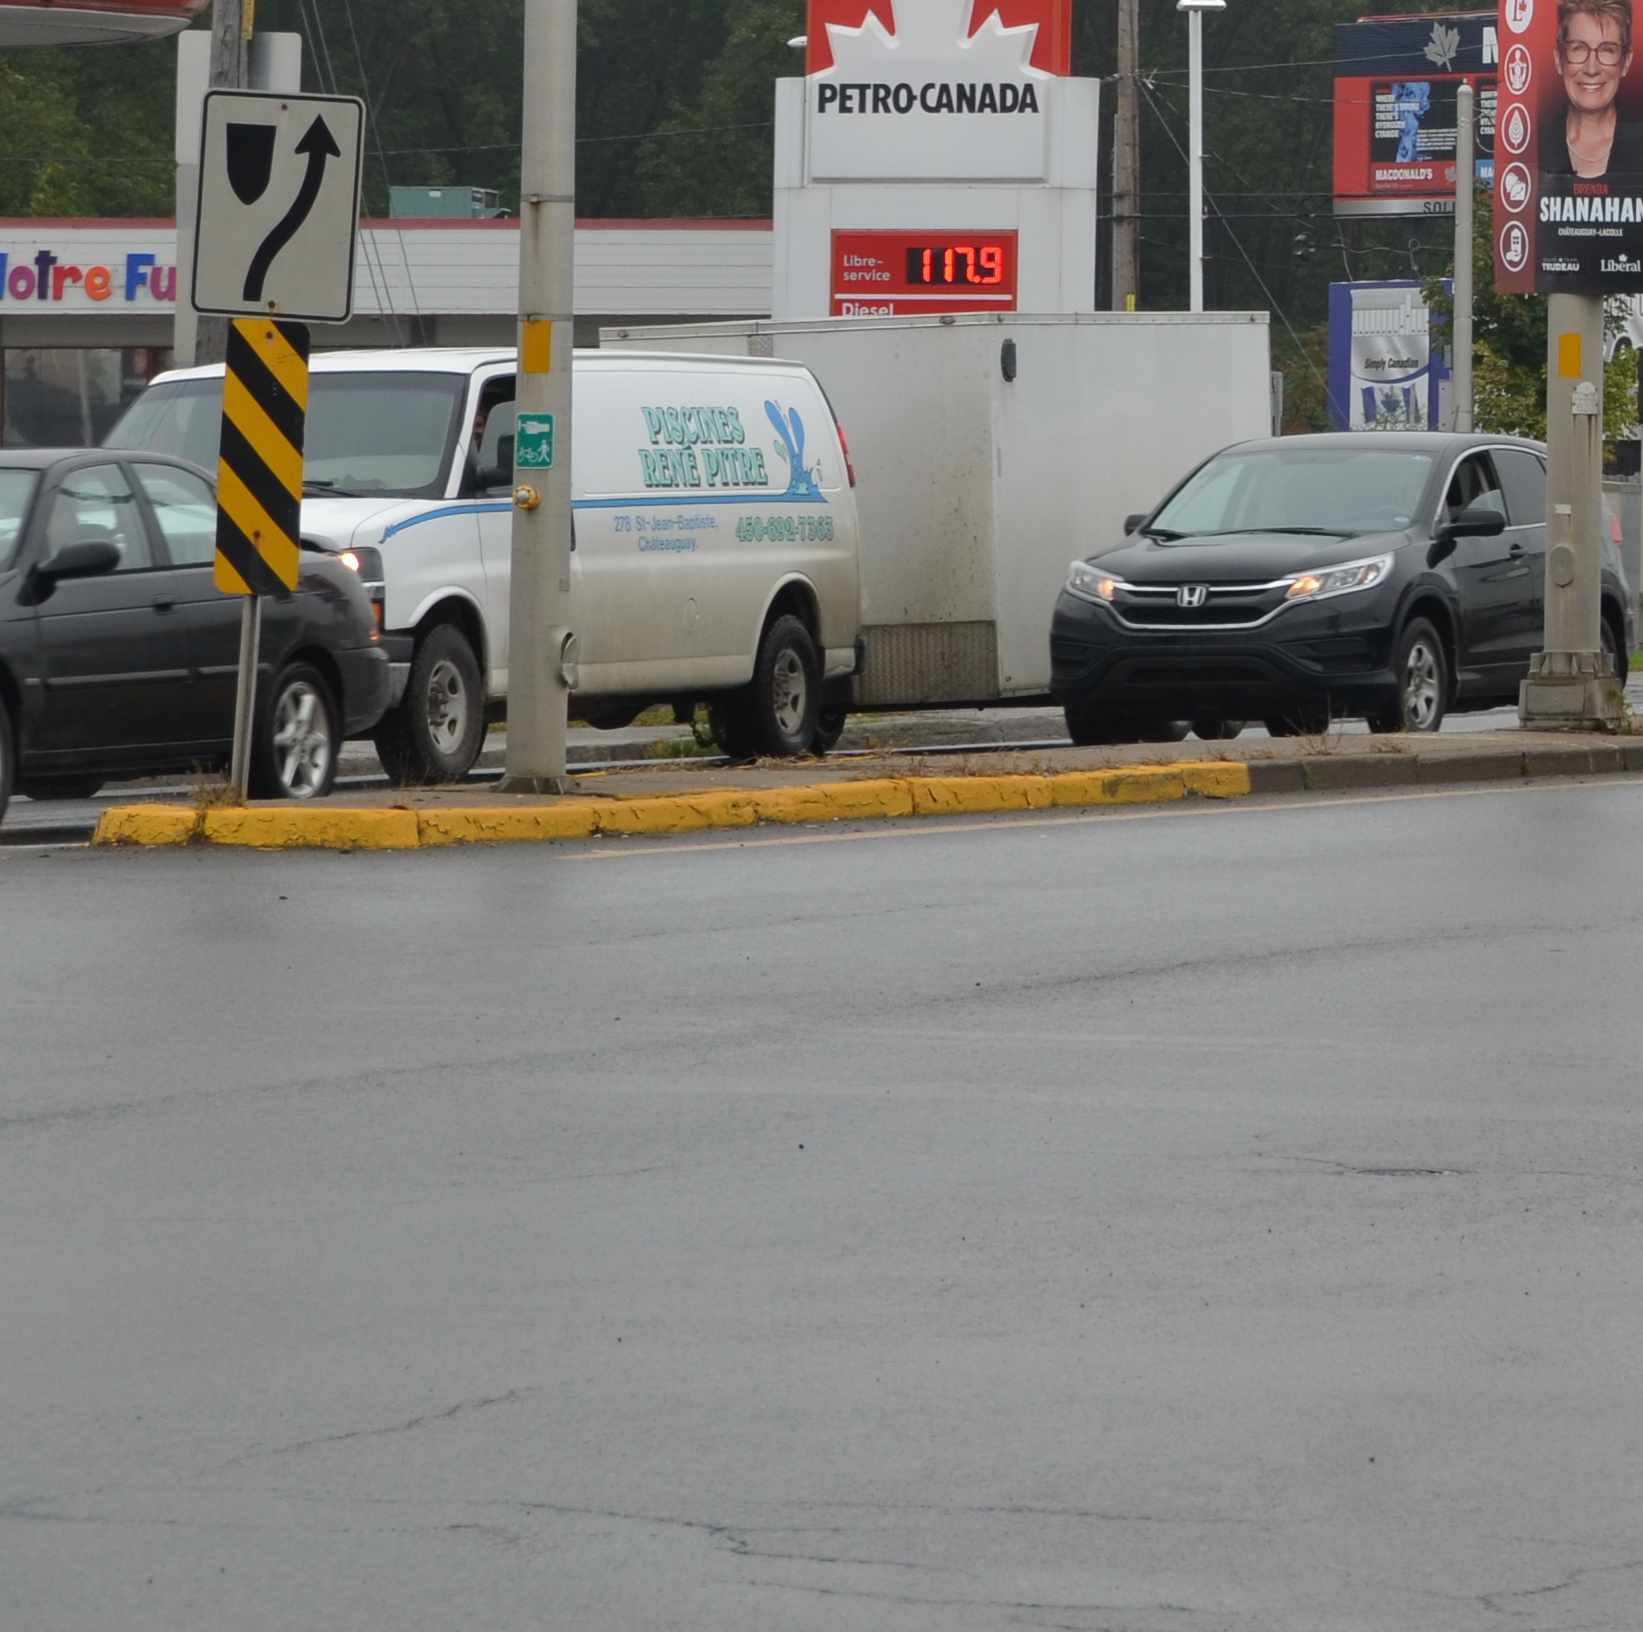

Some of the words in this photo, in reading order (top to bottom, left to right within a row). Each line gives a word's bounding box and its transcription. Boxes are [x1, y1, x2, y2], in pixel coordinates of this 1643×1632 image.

[1375, 168, 1433, 181] MACDONALD'S
[1573, 183, 1609, 195] BRENDA
[843, 255, 884, 268] Libre-
[922, 246, 1003, 285] 117.9
[1541, 262, 1580, 272] TRUDEAU
[0, 250, 112, 302] otre
[843, 269, 891, 282] service
[841, 302, 894, 317] Diesel
[1364, 358, 1386, 371] Simply
[1387, 357, 1419, 369] Canadian
[641, 406, 746, 445] PISCINES
[638, 441, 702, 489] RENÉ
[701, 447, 769, 488] PITRE
[613, 515, 632, 533] 278
